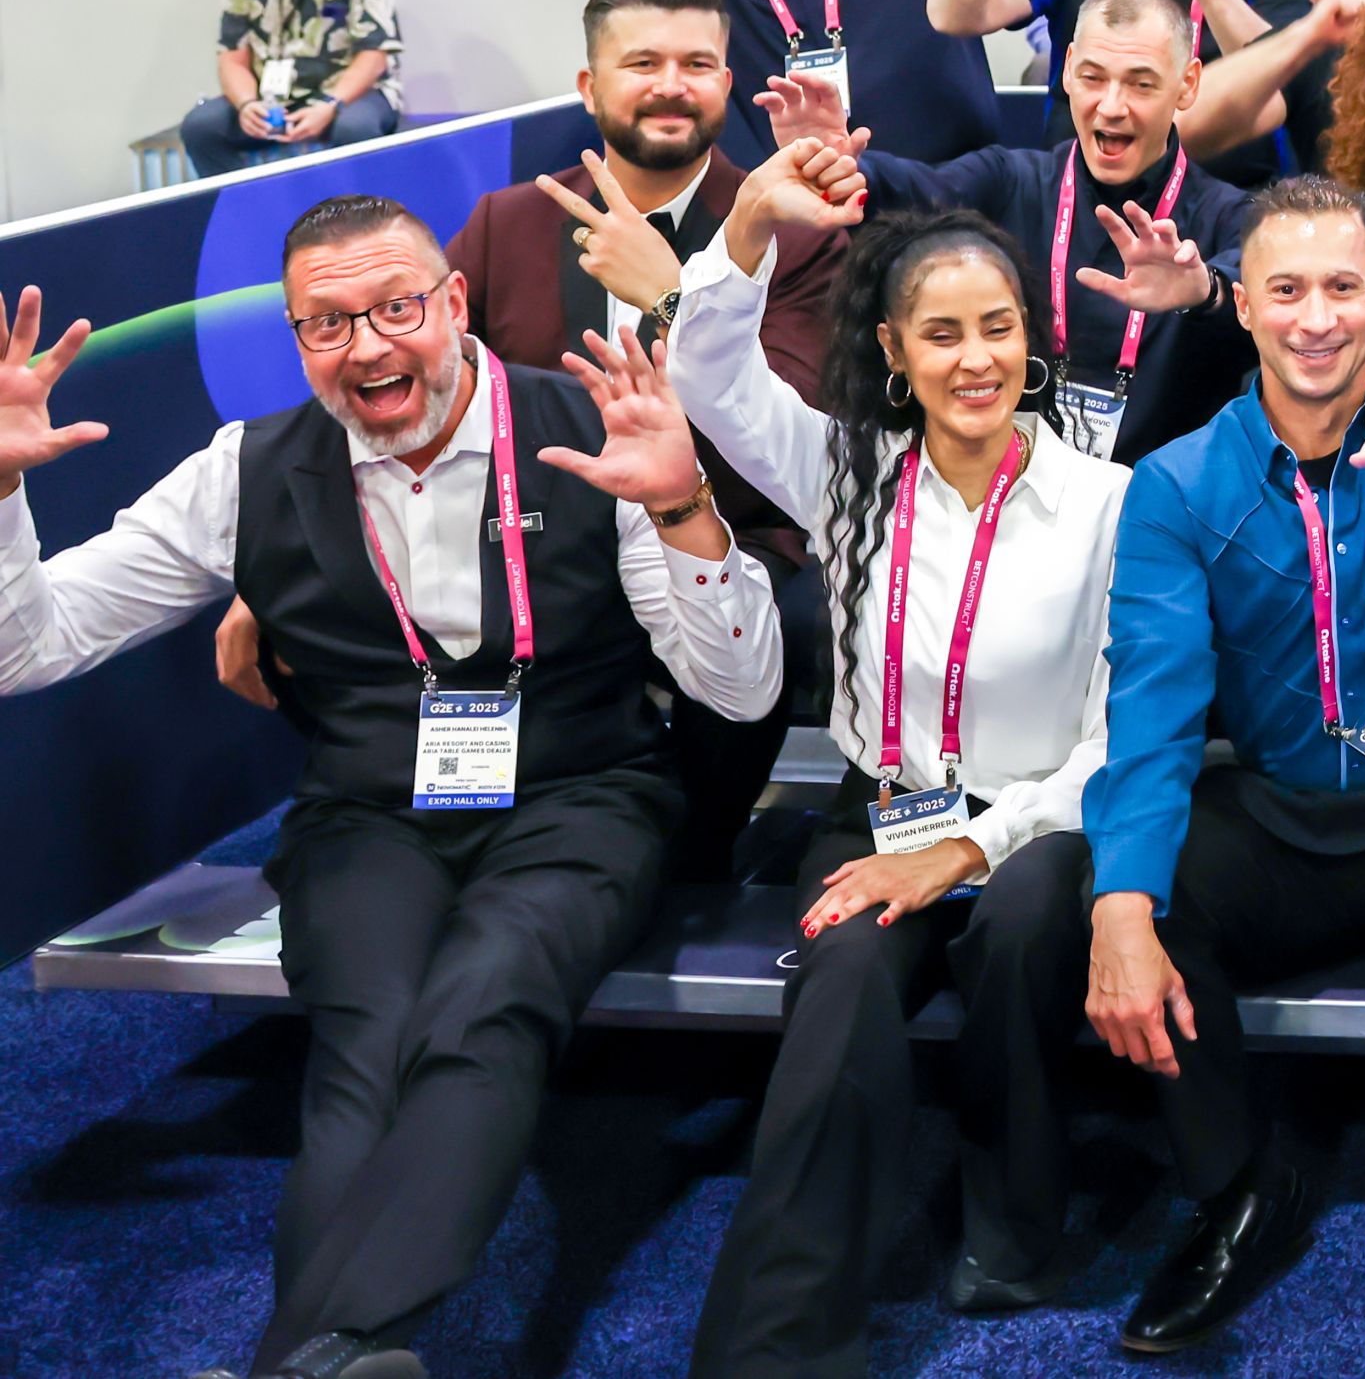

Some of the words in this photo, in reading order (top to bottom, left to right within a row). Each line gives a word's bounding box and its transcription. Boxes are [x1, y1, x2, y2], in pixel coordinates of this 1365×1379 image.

[1058, 208, 1070, 244] Ortak.me
[498, 378, 508, 438] BETCONSTRUCT
[1083, 398, 1108, 410] 2025
[503, 473, 515, 527] Ortak.me
[899, 468, 912, 528] BETCONSTRUCT
[985, 473, 1008, 523] Ortak.me
[1311, 526, 1325, 591] BETCONSTRUCT
[389, 581, 412, 634] Ortak.me
[512, 562, 528, 626] BETCONSTRUCT
[891, 566, 903, 623] Ortak.me
[961, 560, 982, 626] BETCONSTRUCT
[1320, 628, 1331, 683] Ortak.me
[430, 702, 453, 713] G2E
[469, 703, 498, 711] 2025
[887, 662, 897, 727] BETCONSTRUCT
[948, 663, 961, 717] Ortak.me
[878, 807, 902, 822] G2E
[916, 797, 945, 812] 2025
[886, 828, 915, 840] VIVIAN
[918, 818, 957, 833] HERRERA
